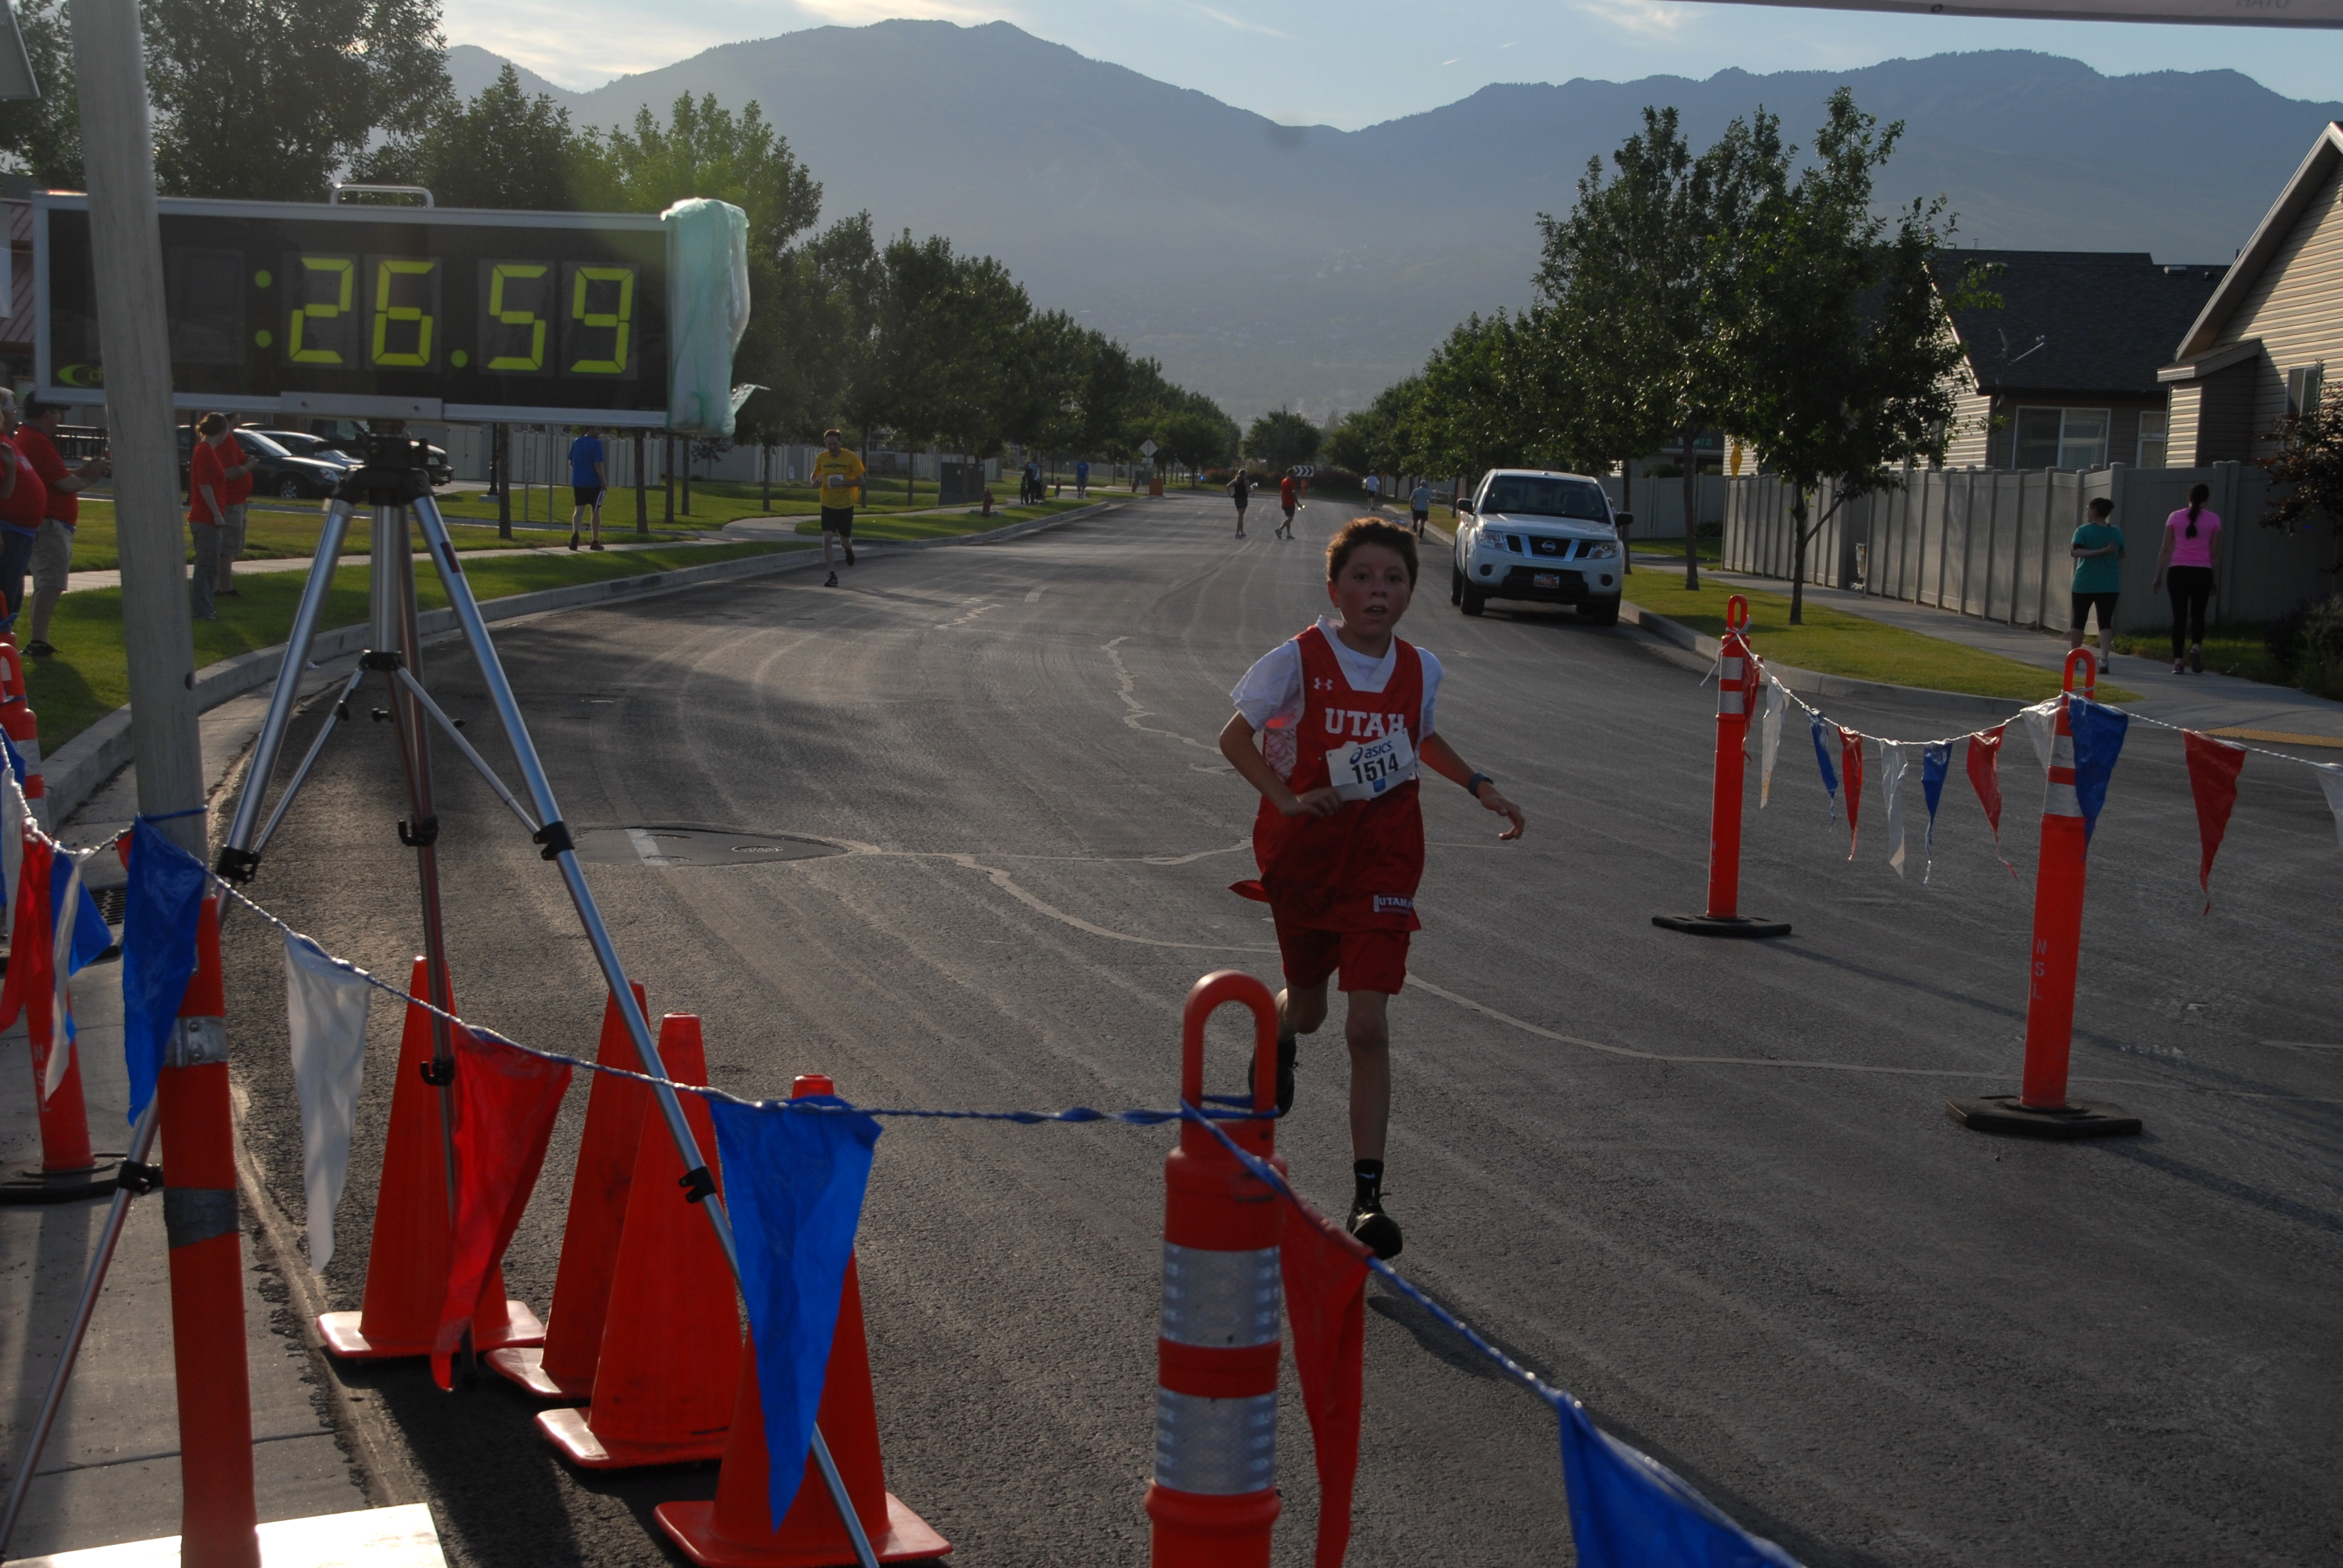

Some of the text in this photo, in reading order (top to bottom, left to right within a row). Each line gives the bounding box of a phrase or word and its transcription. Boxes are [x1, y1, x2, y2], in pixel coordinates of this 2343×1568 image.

[1324, 708, 1404, 738] UTAH
[1364, 741, 1393, 759] asics
[1352, 753, 1398, 784] 1514
